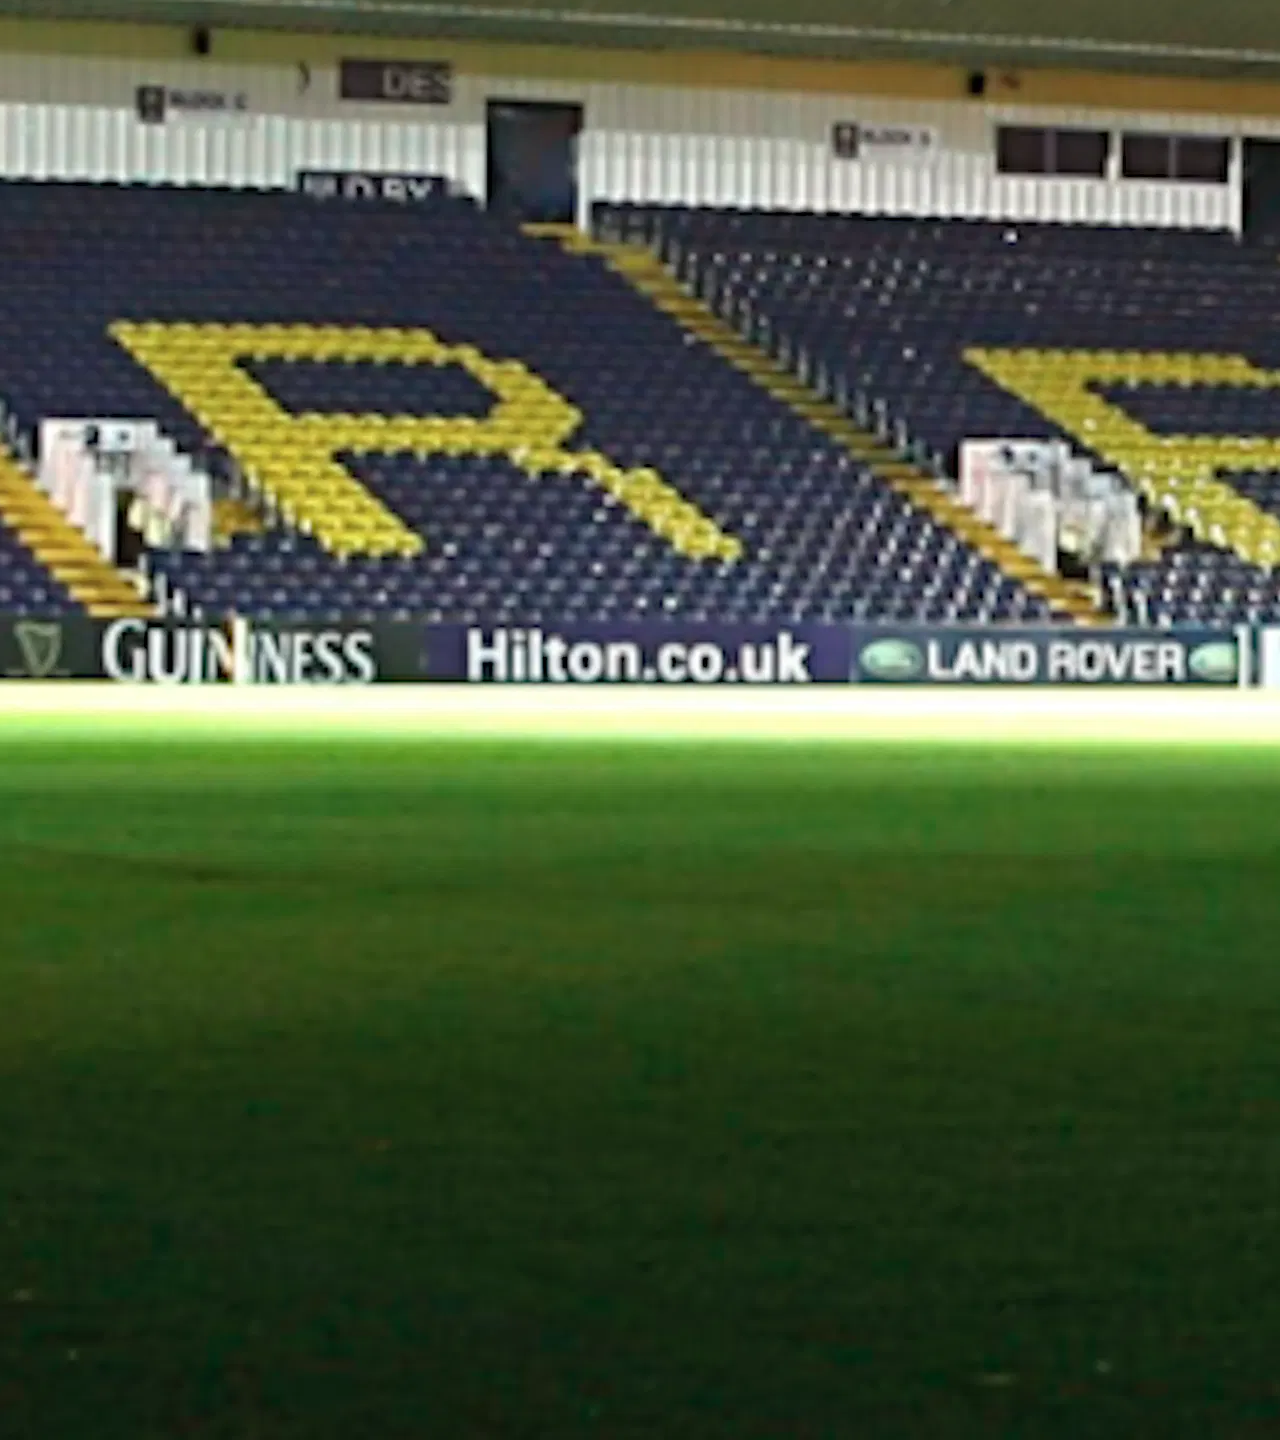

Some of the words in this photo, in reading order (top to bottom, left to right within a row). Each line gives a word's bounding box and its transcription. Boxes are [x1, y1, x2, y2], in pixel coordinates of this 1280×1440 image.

[466, 626, 813, 683] Hilton.co.uk
[927, 638, 1038, 680] LAND
[1048, 639, 1187, 681] ROVER
